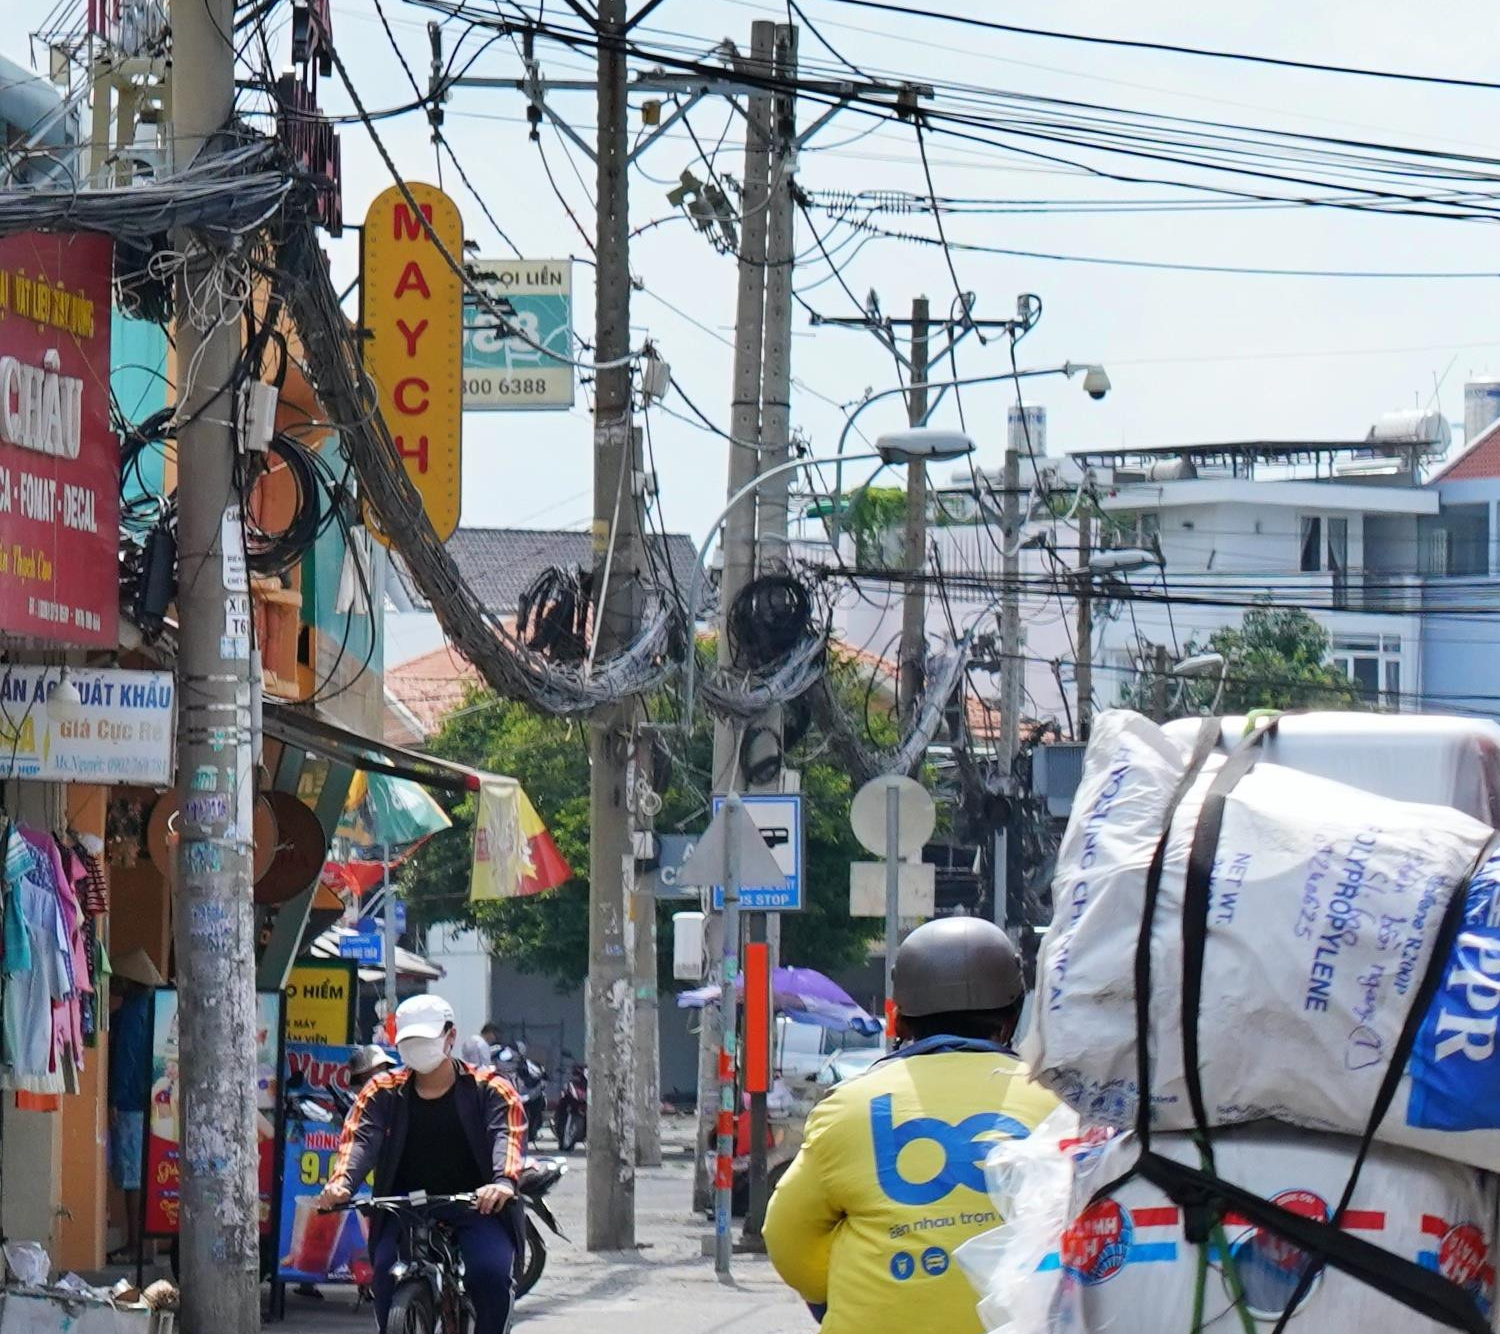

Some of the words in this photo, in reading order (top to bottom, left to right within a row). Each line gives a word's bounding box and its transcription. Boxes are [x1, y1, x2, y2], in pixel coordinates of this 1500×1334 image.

[0, 347, 84, 460] CHÂU
[498, 377, 548, 395] 6388
[63, 482, 98, 534] DECAL
[119, 671, 172, 709] KHẨU
[1304, 831, 1378, 1013] OLYPROPYLENE
[302, 977, 344, 1001] HIỂM
[869, 1092, 1032, 1206] be
[913, 1217, 956, 1233] nhau
[959, 1210, 997, 1228] trọn
